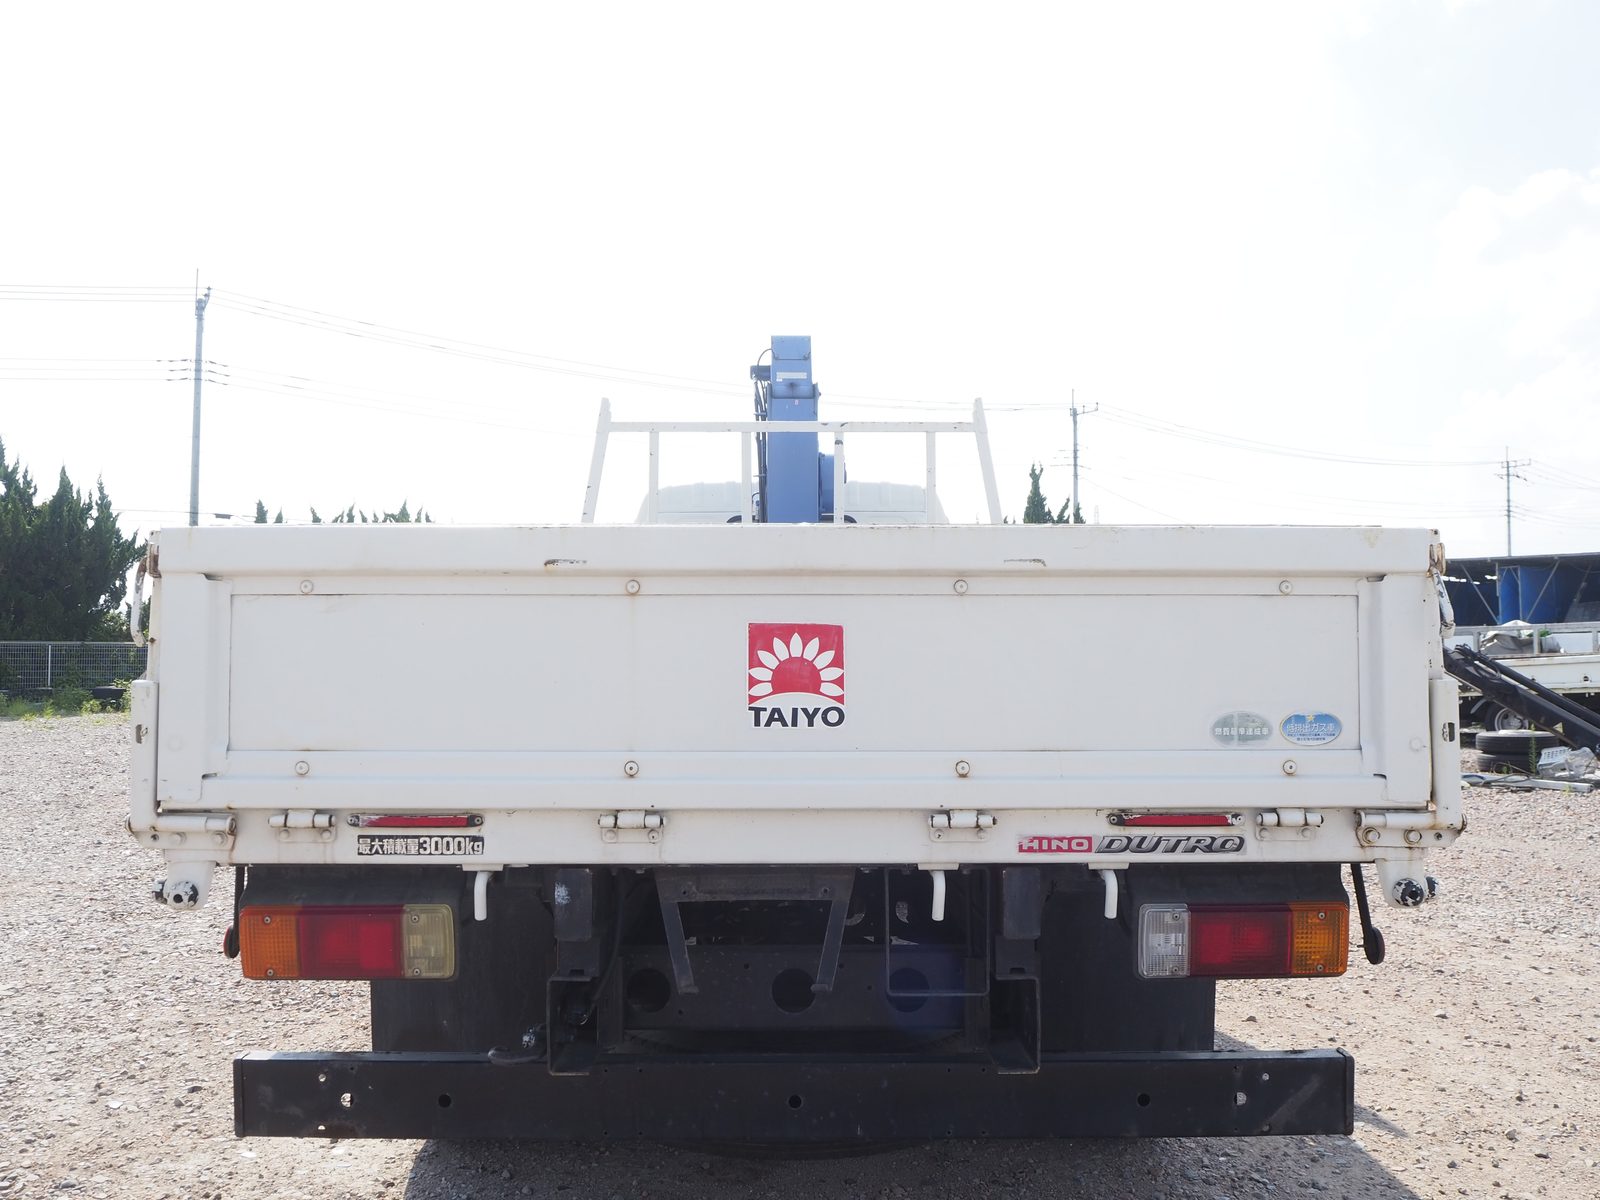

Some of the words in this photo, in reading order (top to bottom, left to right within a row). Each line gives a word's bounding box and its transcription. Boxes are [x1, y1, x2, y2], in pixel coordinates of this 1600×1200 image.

[748, 706, 846, 728] TAIYO
[358, 836, 483, 855] 最大積載量3000kg
[1019, 836, 1090, 851] HINO
[1094, 835, 1245, 854] DUTRO
